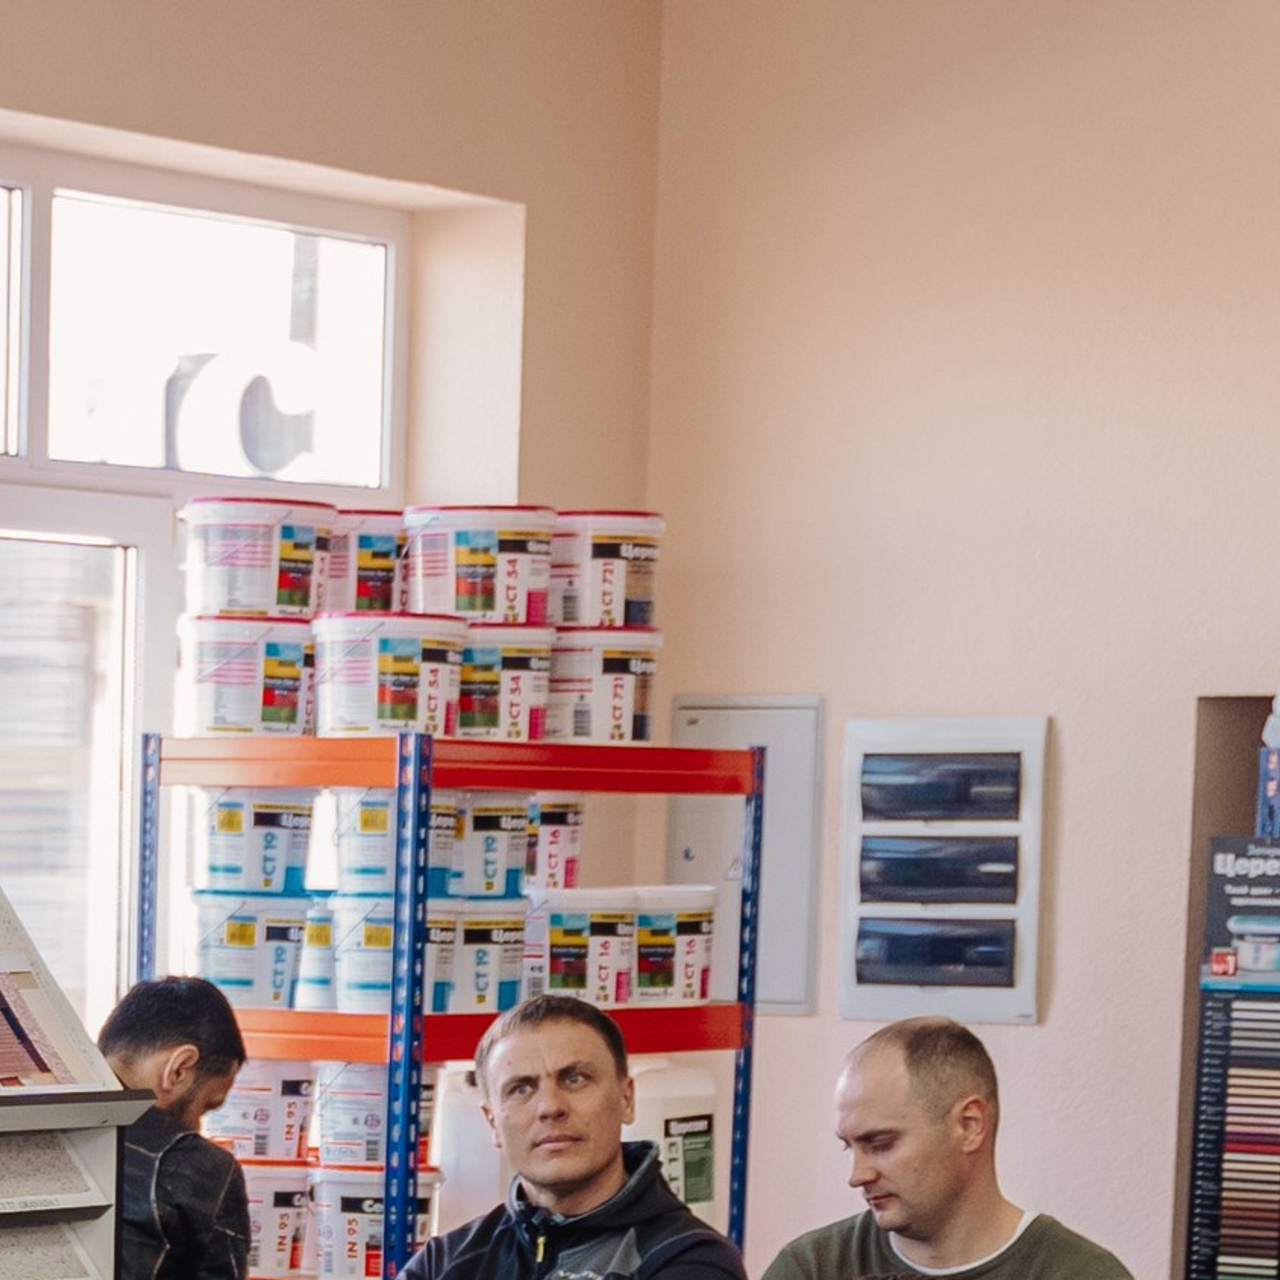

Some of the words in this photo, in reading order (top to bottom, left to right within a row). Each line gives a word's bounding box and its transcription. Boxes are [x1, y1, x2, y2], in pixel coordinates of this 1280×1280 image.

[506, 558, 518, 579] 54
[506, 584, 518, 604] CT
[602, 590, 614, 607] CT
[429, 667, 440, 689] 54
[510, 675, 522, 696] 54
[428, 694, 439, 713] CT
[509, 702, 521, 720] CT
[613, 704, 624, 722] CT
[484, 835, 497, 855] 19
[549, 828, 561, 845] 16
[263, 855, 276, 877] CT
[484, 858, 497, 879] CT
[548, 852, 560, 870] CT
[476, 948, 490, 967] 19
[598, 940, 611, 958] 16
[273, 969, 285, 990] CT
[475, 971, 489, 993] CT
[597, 964, 610, 982] CT
[286, 1101, 298, 1119] 95
[284, 1123, 295, 1141] IN
[278, 1212, 290, 1231] 95
[347, 1218, 360, 1237] 95
[276, 1235, 287, 1253] IN
[346, 1241, 359, 1259] IN
